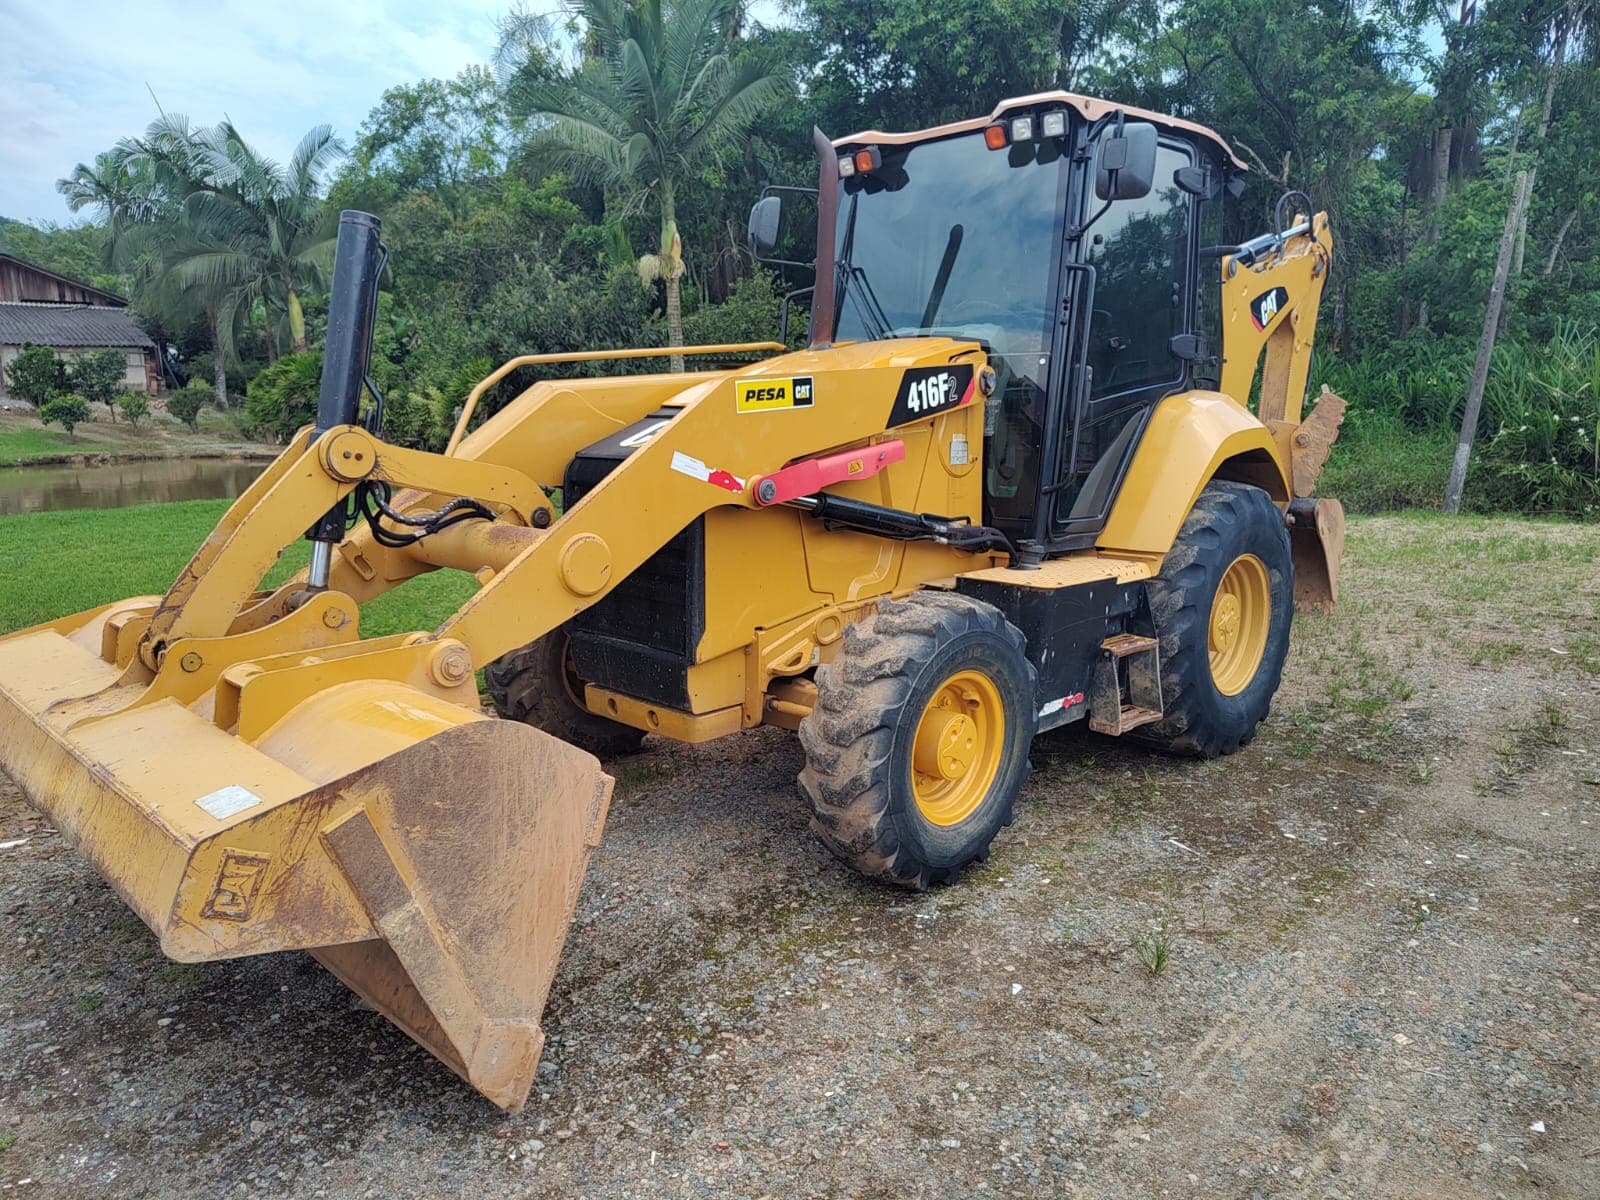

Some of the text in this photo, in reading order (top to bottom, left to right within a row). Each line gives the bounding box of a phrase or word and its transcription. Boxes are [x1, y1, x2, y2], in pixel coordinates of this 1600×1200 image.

[1260, 288, 1278, 327] CAT
[744, 384, 811, 403] PESA CAT
[205, 855, 266, 919] CAT
